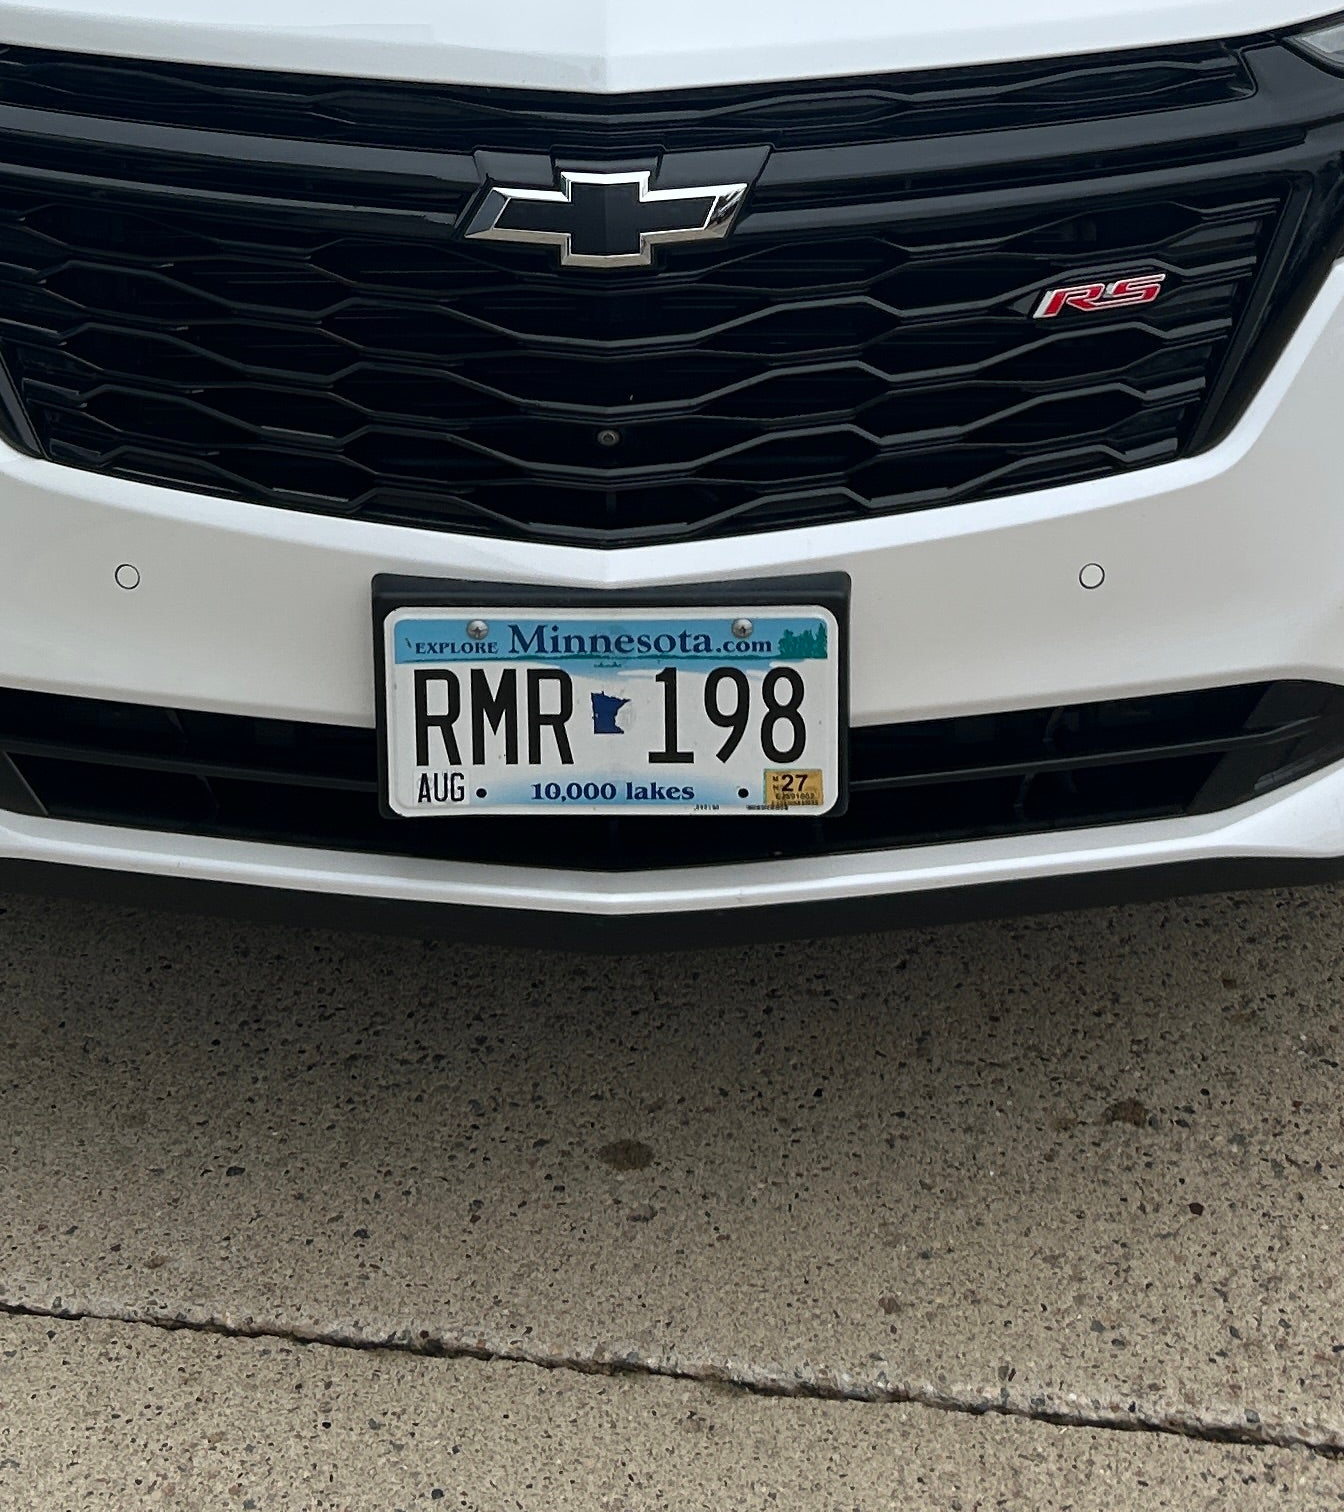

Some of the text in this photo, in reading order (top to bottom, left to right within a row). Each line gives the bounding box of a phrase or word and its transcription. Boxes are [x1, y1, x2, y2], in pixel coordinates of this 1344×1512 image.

[1032, 273, 1166, 319] RS
[415, 641, 498, 655] EXPLORE
[413, 666, 807, 767] RMR 198
[417, 772, 466, 804] AUG
[531, 781, 695, 802] 10,000 lakes
[781, 774, 808, 792] 27
